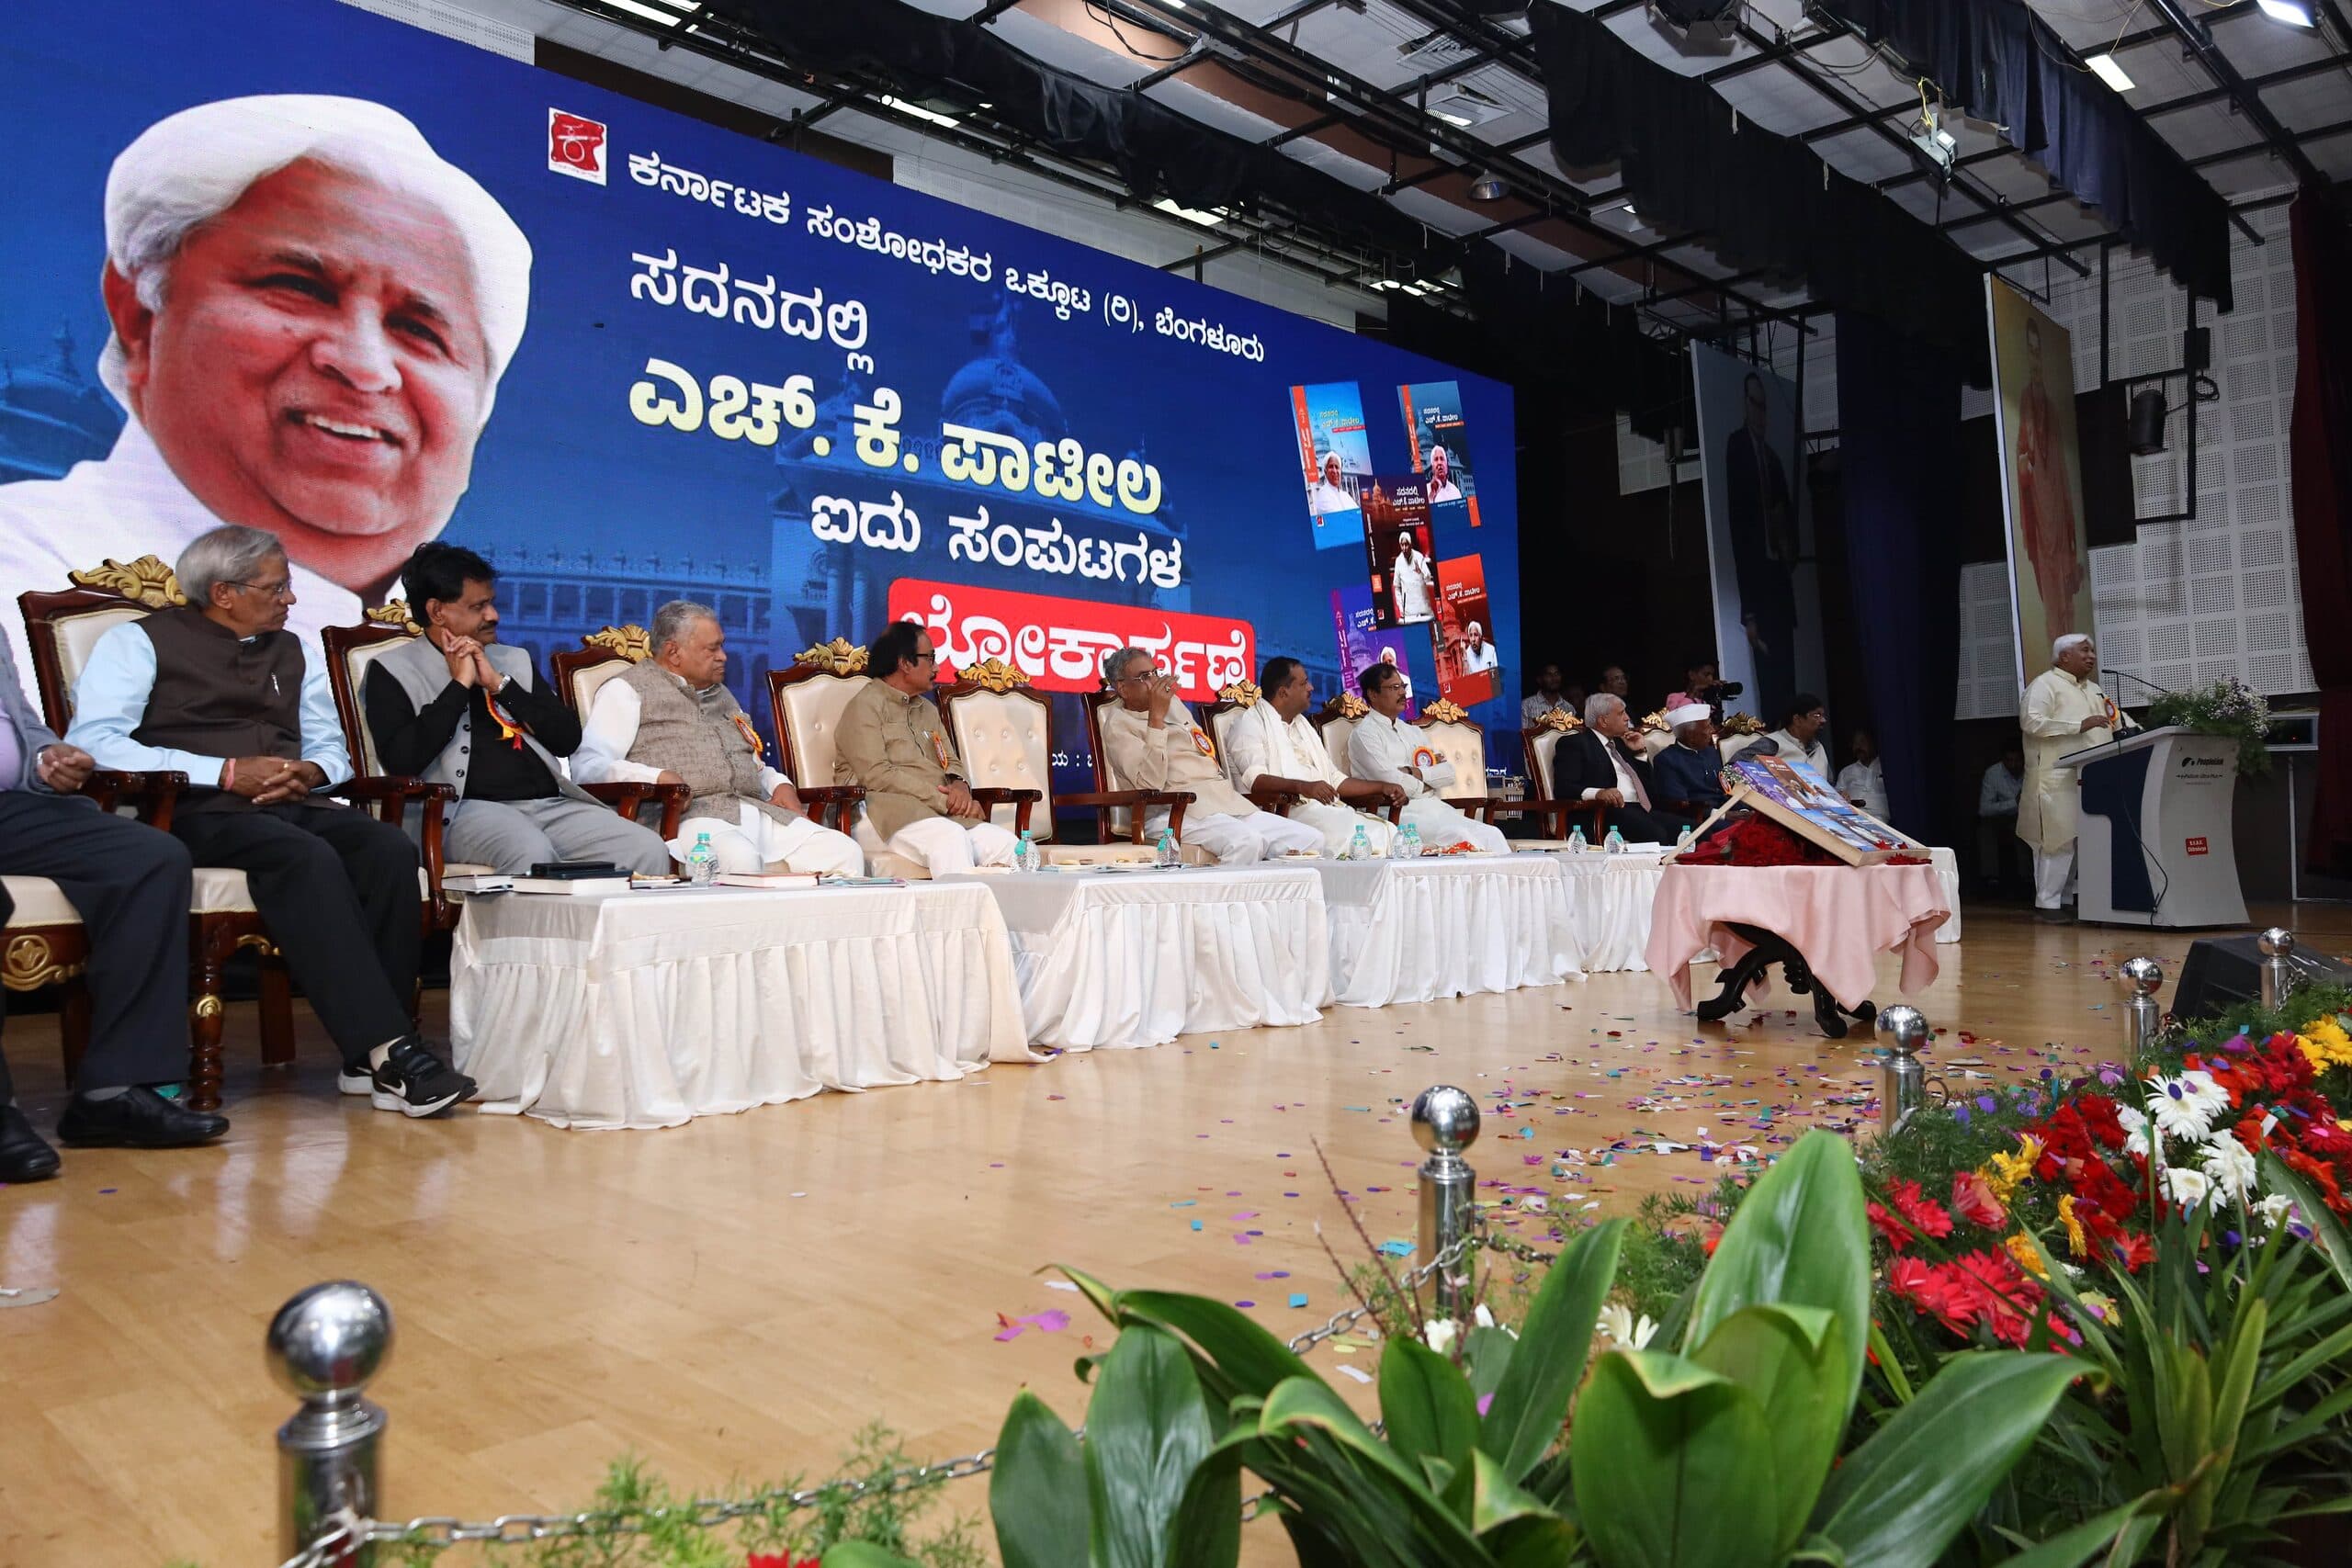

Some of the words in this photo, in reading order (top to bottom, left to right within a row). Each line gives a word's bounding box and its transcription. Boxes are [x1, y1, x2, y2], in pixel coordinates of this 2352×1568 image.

[629, 151, 790, 224] ಕರ್ನಾಟಕ
[807, 205, 992, 281] ಸಂಶೋಧಕರ
[1005, 267, 1091, 321] ಒಕ್ಕೂಟ
[1103, 291, 1145, 333] (ರಿ),
[1155, 306, 1264, 363] ಬೆಂಗಳೂರು
[630, 248, 875, 375] ಸದನದಲ್ಲಿ
[940, 422, 1162, 514] ಪಾಟೀಲ
[811, 490, 922, 553] ಐದು
[948, 504, 1182, 589] ಸಂಪುಟಗಳ
